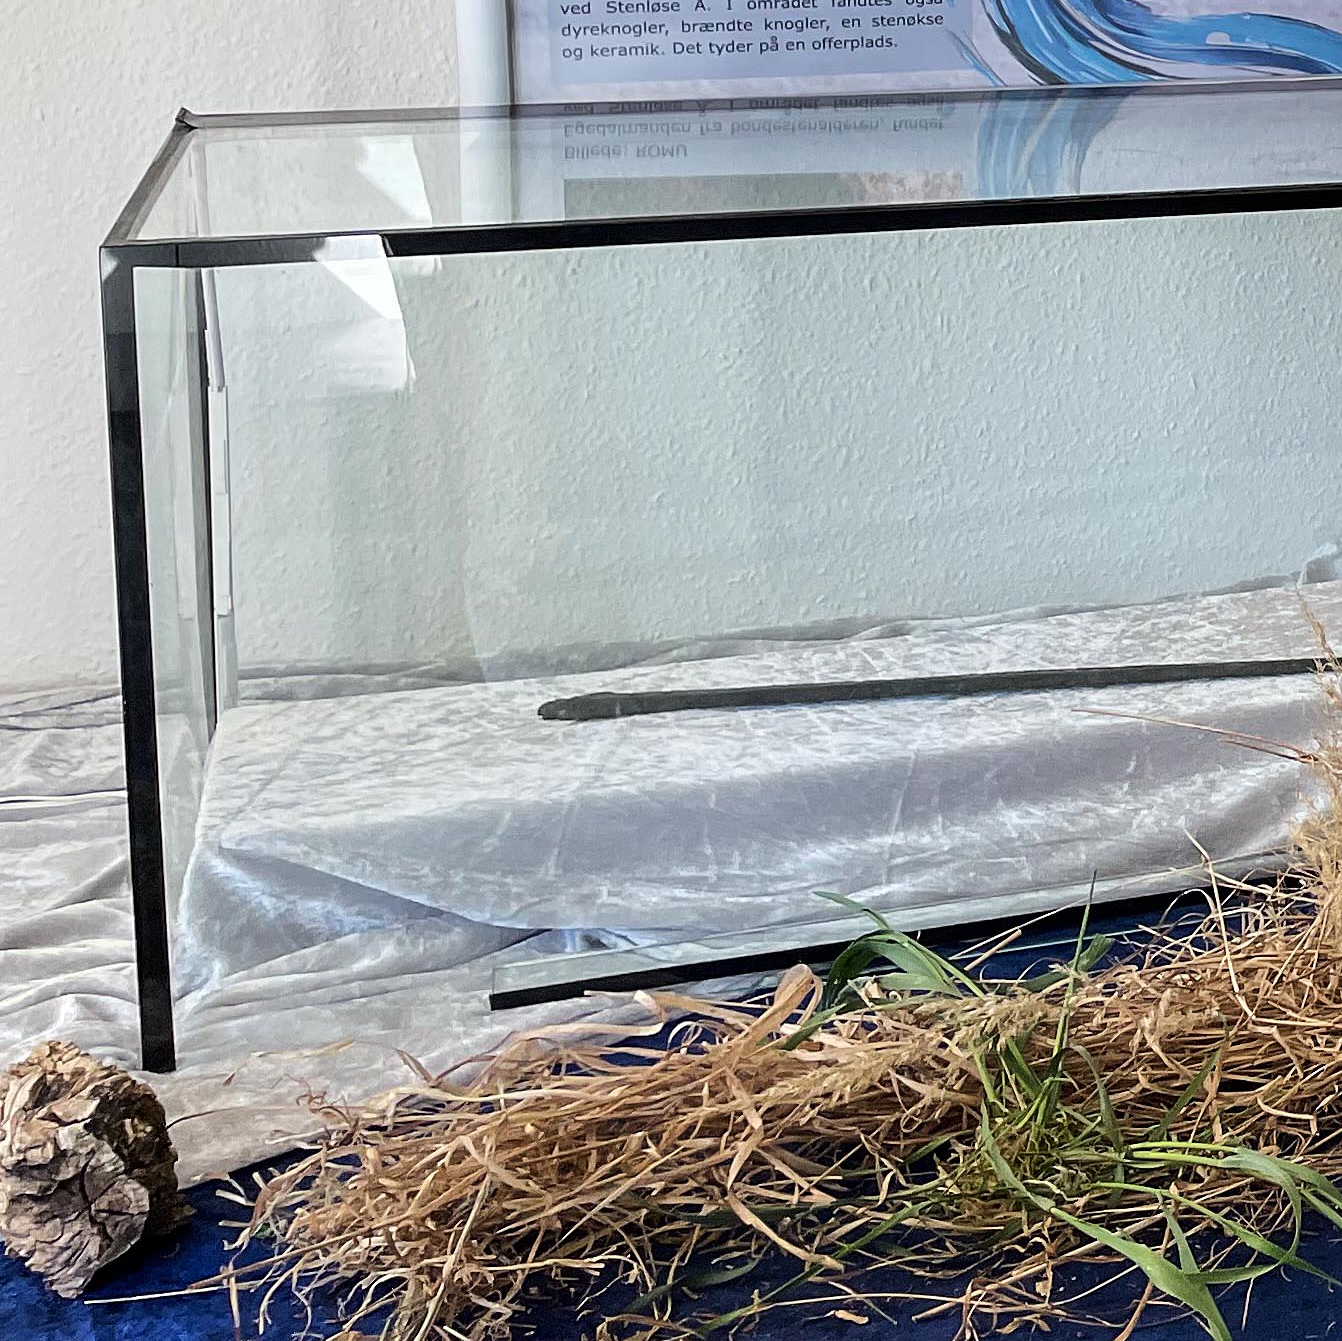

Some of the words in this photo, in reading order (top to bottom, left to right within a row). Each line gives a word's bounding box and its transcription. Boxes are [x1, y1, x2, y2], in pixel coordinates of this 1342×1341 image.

[559, 1, 591, 15] ved
[561, 20, 669, 40] dyreknogler,
[681, 18, 753, 33] brændte
[764, 16, 830, 33] knogler,
[841, 17, 861, 29] en
[871, 12, 944, 28] stenøkse
[562, 47, 583, 61] og
[590, 42, 665, 57] keramik.
[672, 41, 703, 55] Det
[708, 39, 754, 57] tyder
[759, 35, 779, 55] på
[785, 40, 806, 51] en
[811, 34, 898, 52] offerplads.
